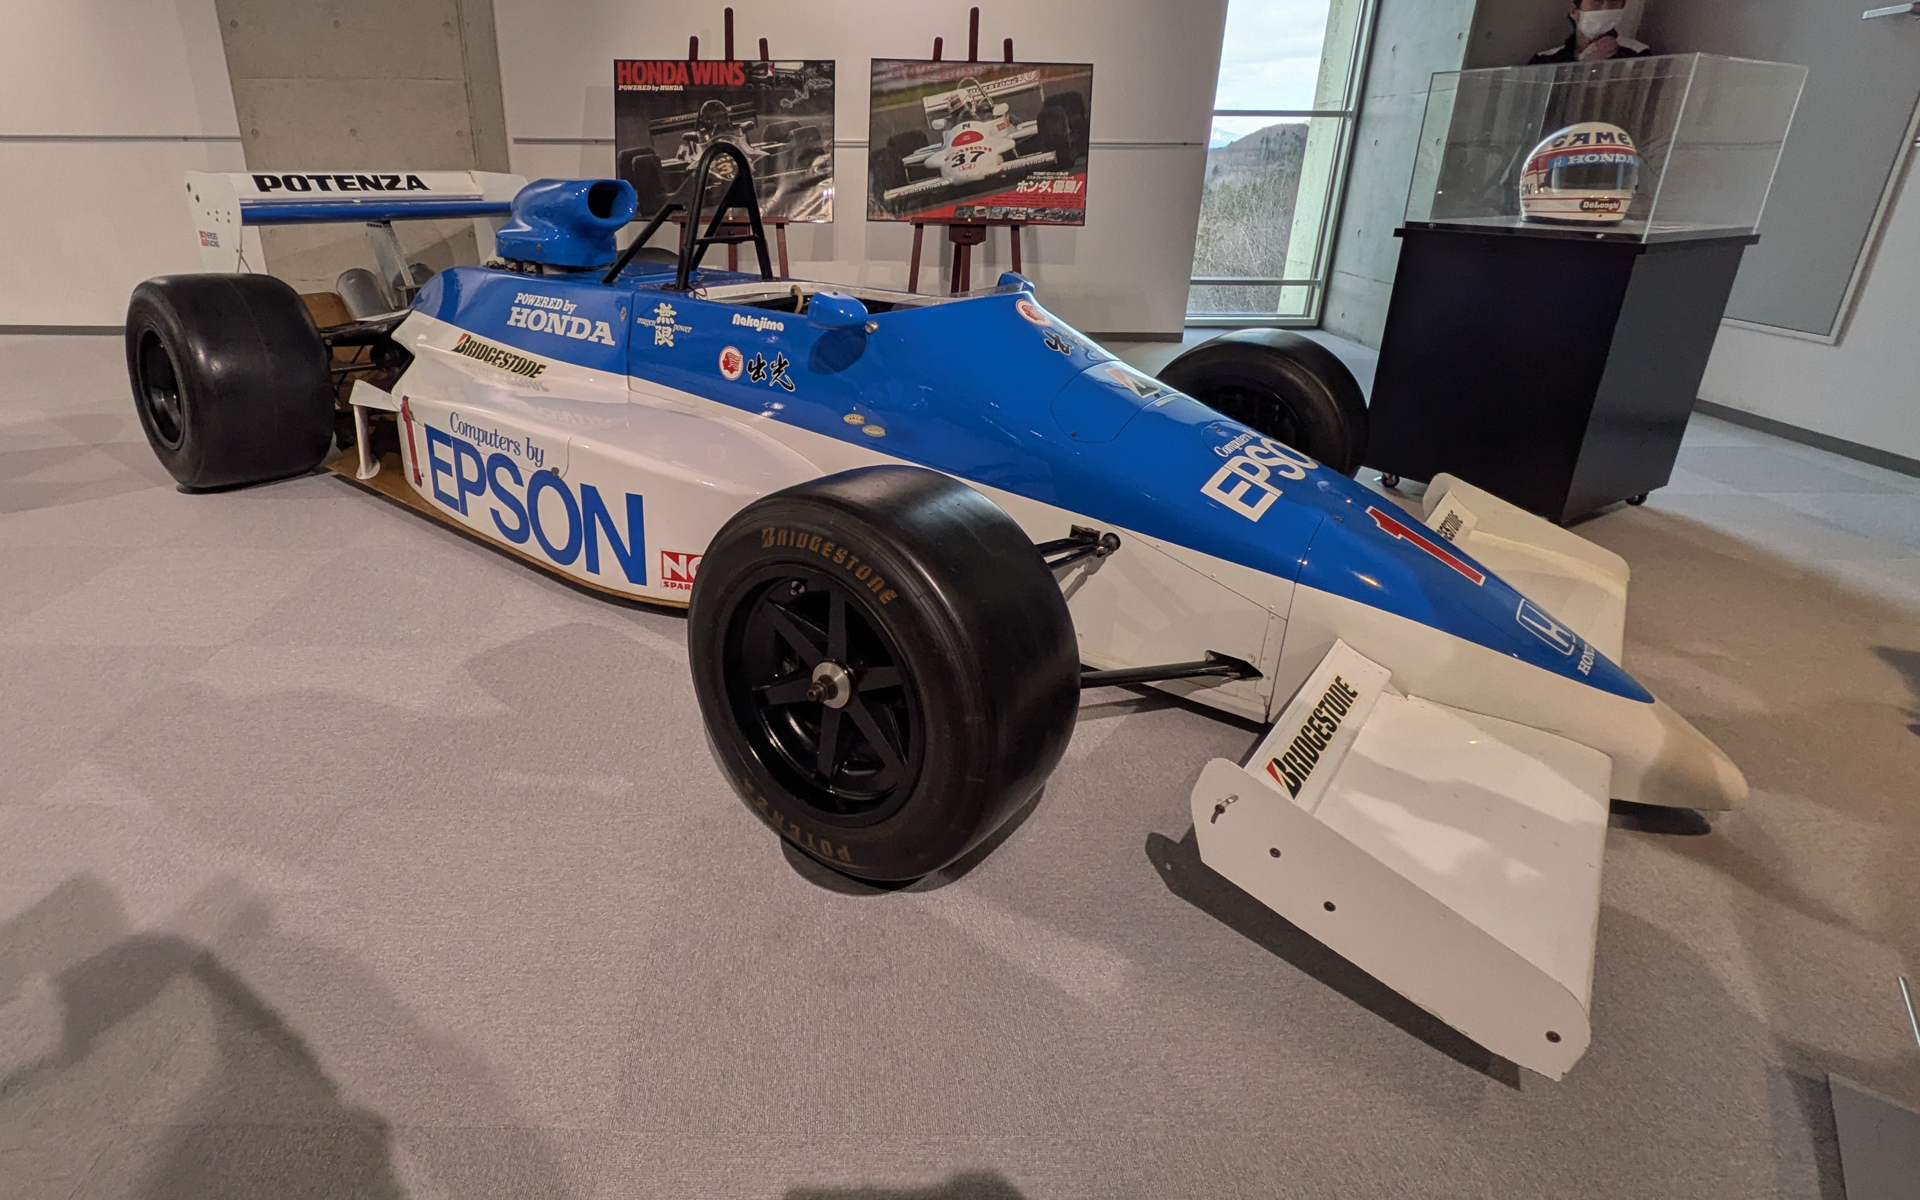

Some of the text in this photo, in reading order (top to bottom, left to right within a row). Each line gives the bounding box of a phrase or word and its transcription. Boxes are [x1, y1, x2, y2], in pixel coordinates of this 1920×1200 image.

[616, 61, 746, 86] HONDA WINS
[951, 151, 985, 168] 37
[1567, 153, 1635, 165] HONDA
[251, 174, 431, 193] POTENZA
[514, 292, 577, 314] POWERED by
[732, 313, 785, 333] Nakajima
[506, 306, 616, 346] HONDA
[451, 332, 547, 379] BRIDGESTONE
[747, 352, 796, 392] 出光
[450, 411, 544, 468] Computers by
[424, 423, 647, 587] EPSON
[761, 527, 898, 606] BRIDGESTONE
[1266, 675, 1359, 800] BRIDGESTONE
